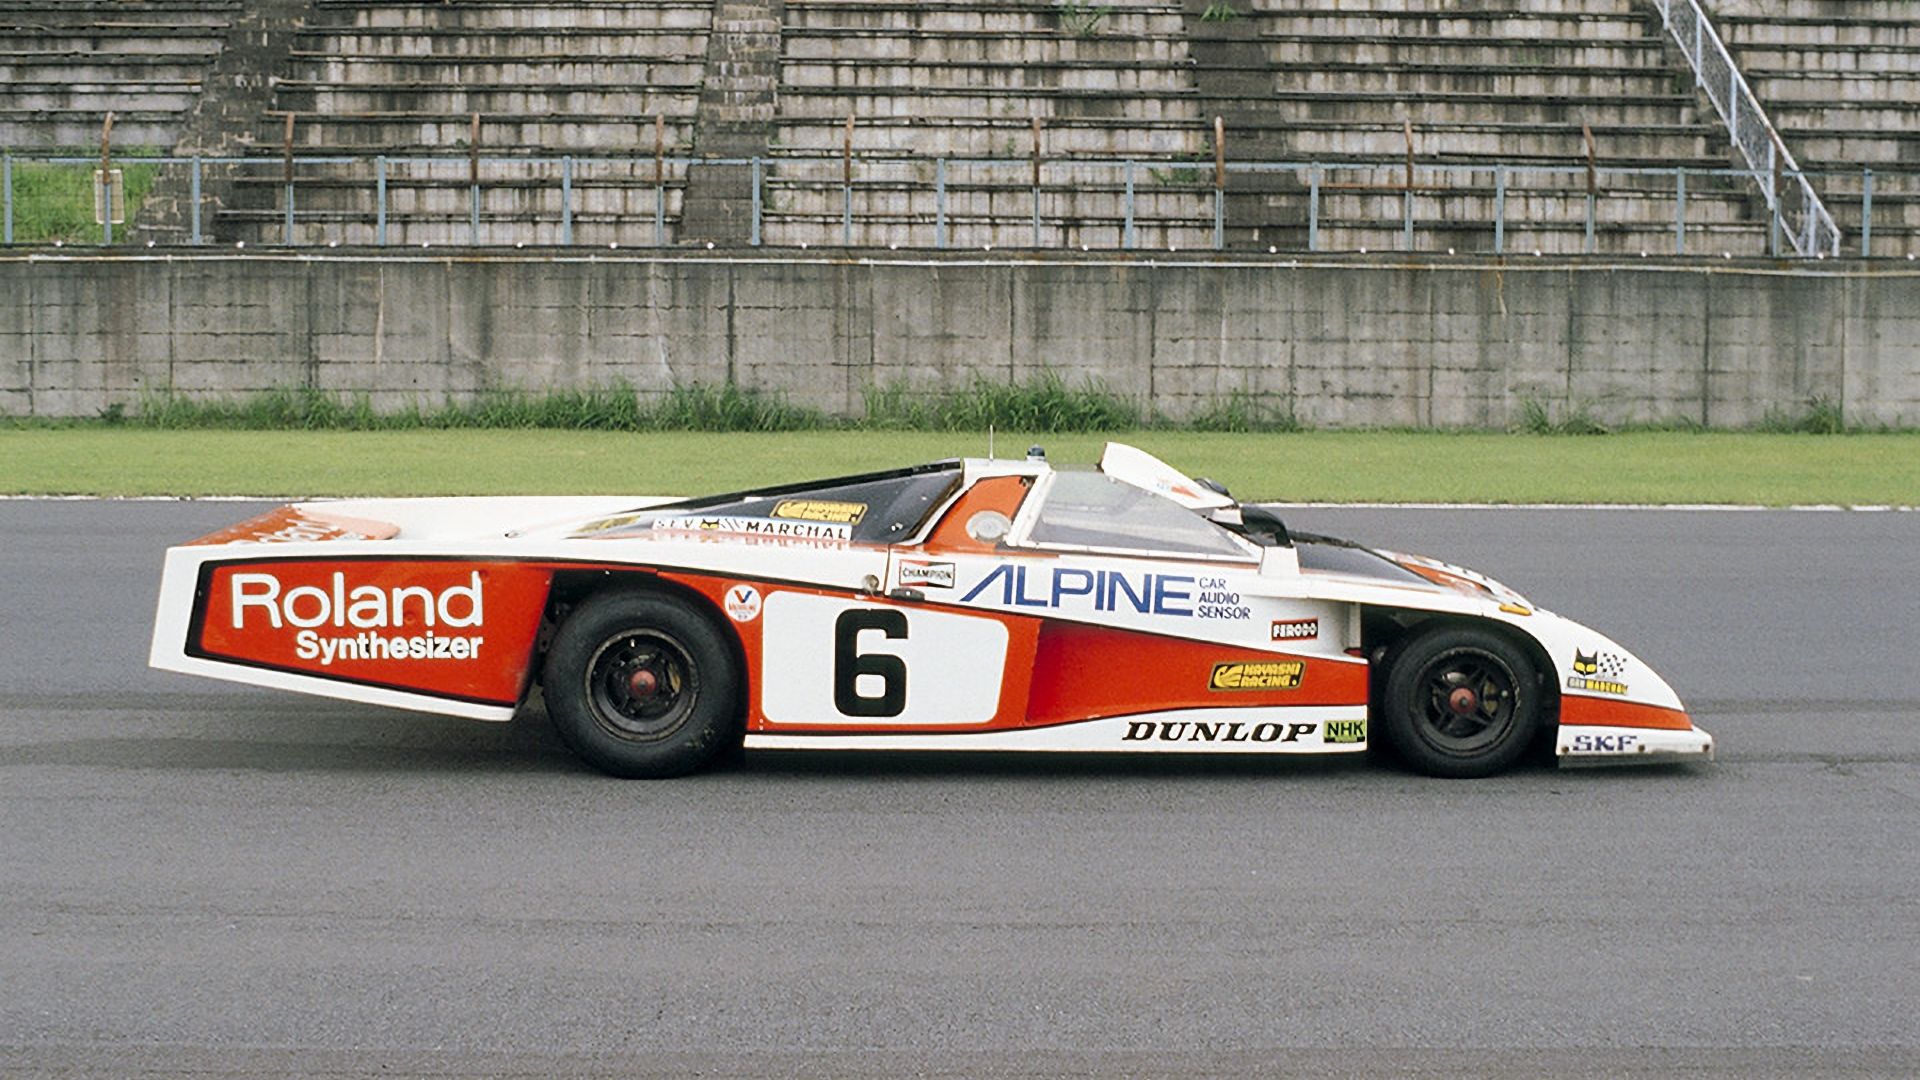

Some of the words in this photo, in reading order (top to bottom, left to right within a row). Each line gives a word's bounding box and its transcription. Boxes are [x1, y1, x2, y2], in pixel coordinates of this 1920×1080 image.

[745, 521, 847, 540] MARCHAL
[959, 564, 1196, 617] ALPINE
[1199, 576, 1227, 590] CAR
[230, 571, 484, 630] Roland
[1198, 591, 1240, 606] AUDIO
[1197, 604, 1251, 619] SENSOR
[295, 630, 484, 665] Synthesizer
[834, 608, 909, 718] 6
[1122, 721, 1317, 743] DUNLOP
[1327, 720, 1364, 737] NHK
[1572, 735, 1638, 751] SKF
